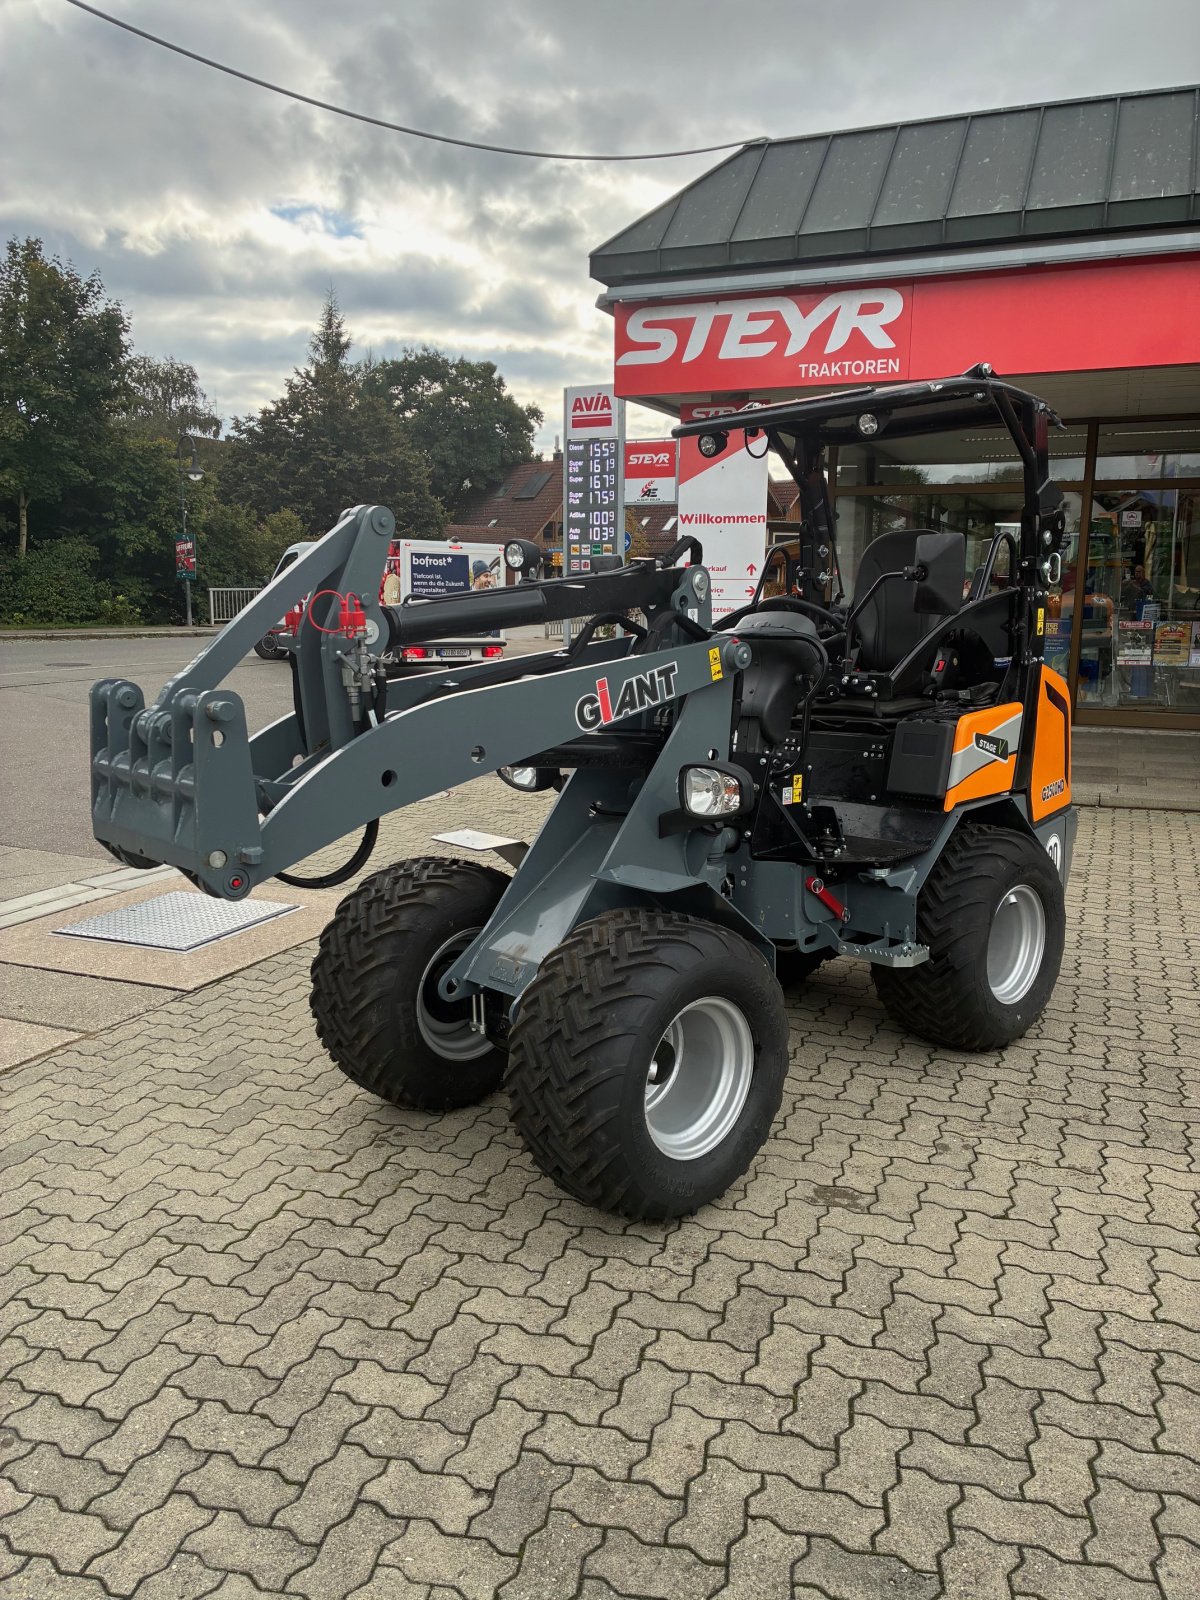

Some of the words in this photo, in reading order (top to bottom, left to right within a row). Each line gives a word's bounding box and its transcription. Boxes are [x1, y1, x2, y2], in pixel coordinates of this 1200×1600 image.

[616, 288, 904, 366] STEYR
[799, 358, 900, 378] TRAKTOREN
[572, 392, 612, 412] AVIA
[590, 443, 615, 457] 1559
[569, 460, 583, 468] Super
[628, 453, 670, 464] STEYR
[590, 459, 615, 472] 1619
[590, 475, 615, 488] 1679
[569, 492, 583, 500] Super
[590, 491, 615, 504] 1759
[590, 511, 615, 525] 1009
[680, 513, 766, 525] Willkommen
[590, 527, 615, 540] 1039
[979, 739, 997, 753] STAGE
